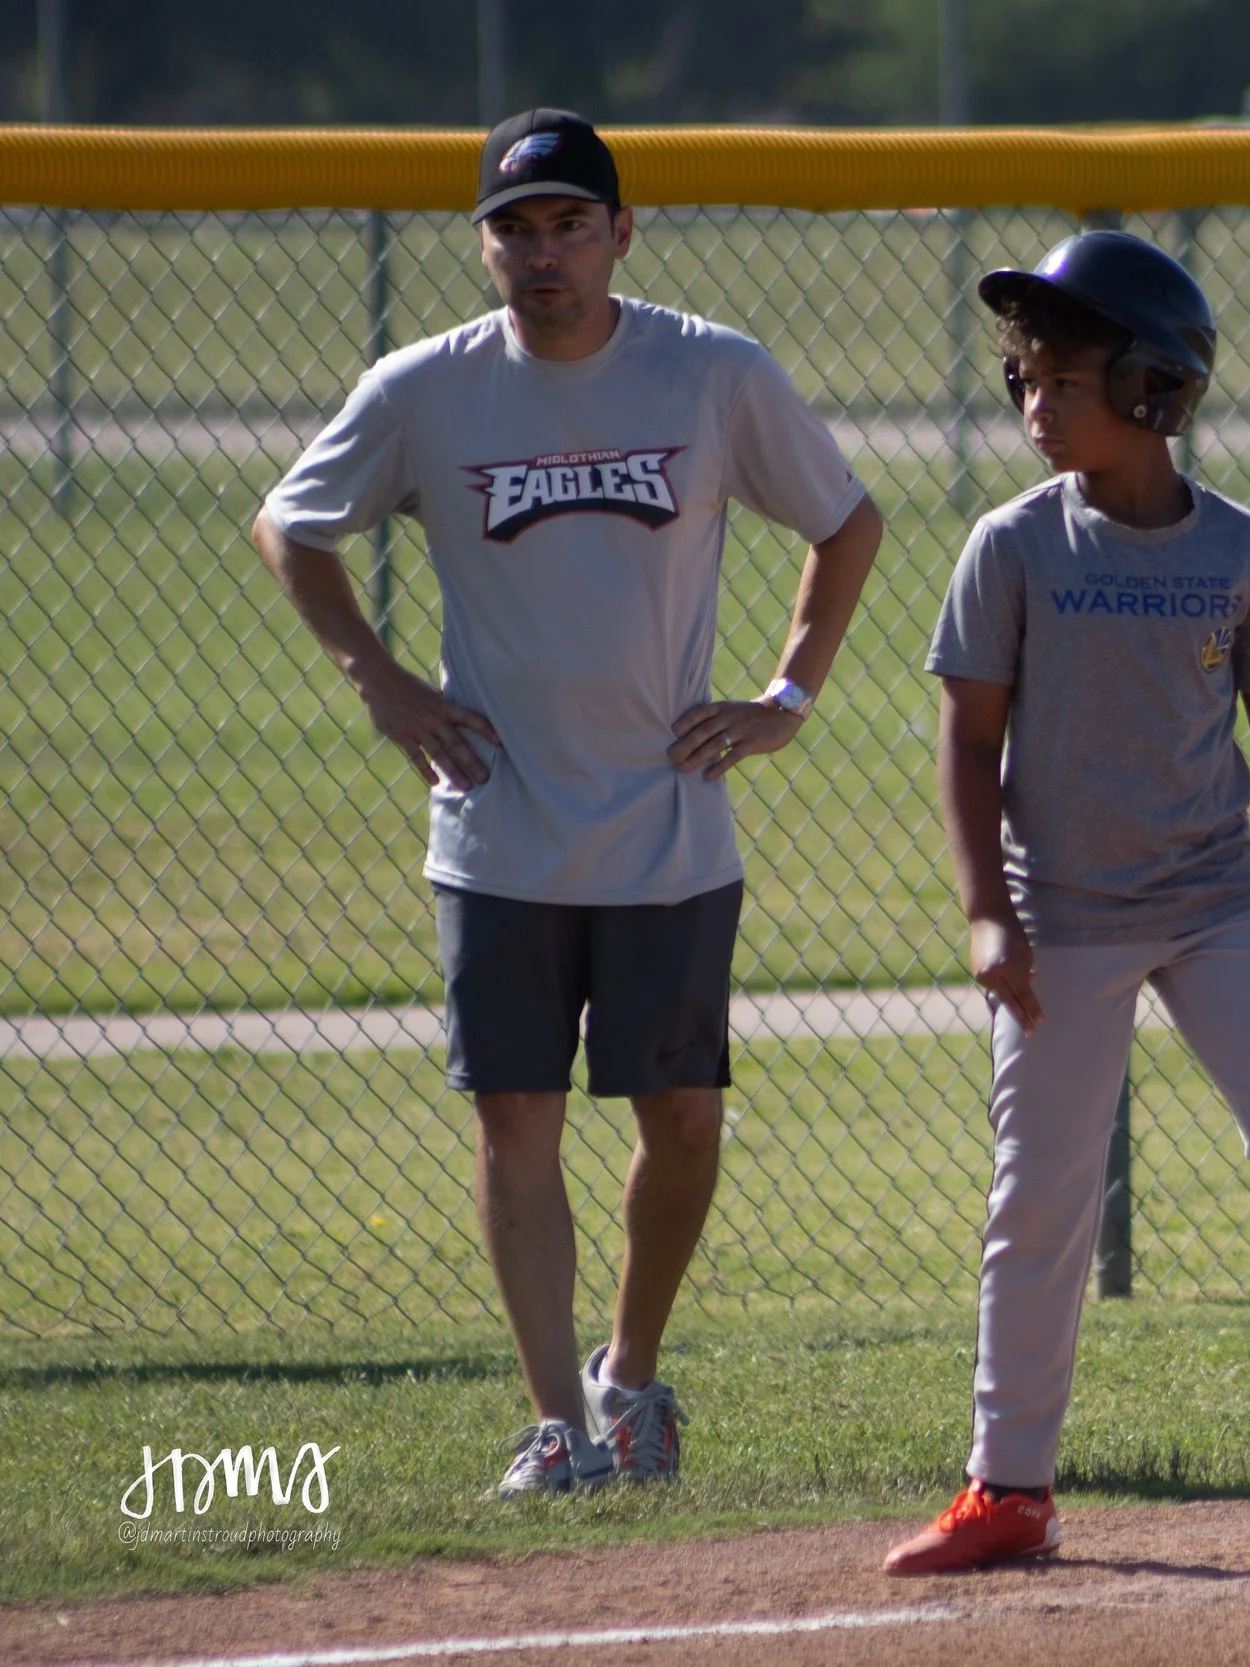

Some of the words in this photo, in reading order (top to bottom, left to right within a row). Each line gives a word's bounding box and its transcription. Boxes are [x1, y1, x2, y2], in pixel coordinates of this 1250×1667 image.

[535, 449, 621, 467] MIDLOTHIAN
[481, 452, 676, 532] EAGLES
[1084, 573, 1167, 590] GOLDEN
[1171, 576, 1231, 590] STATE
